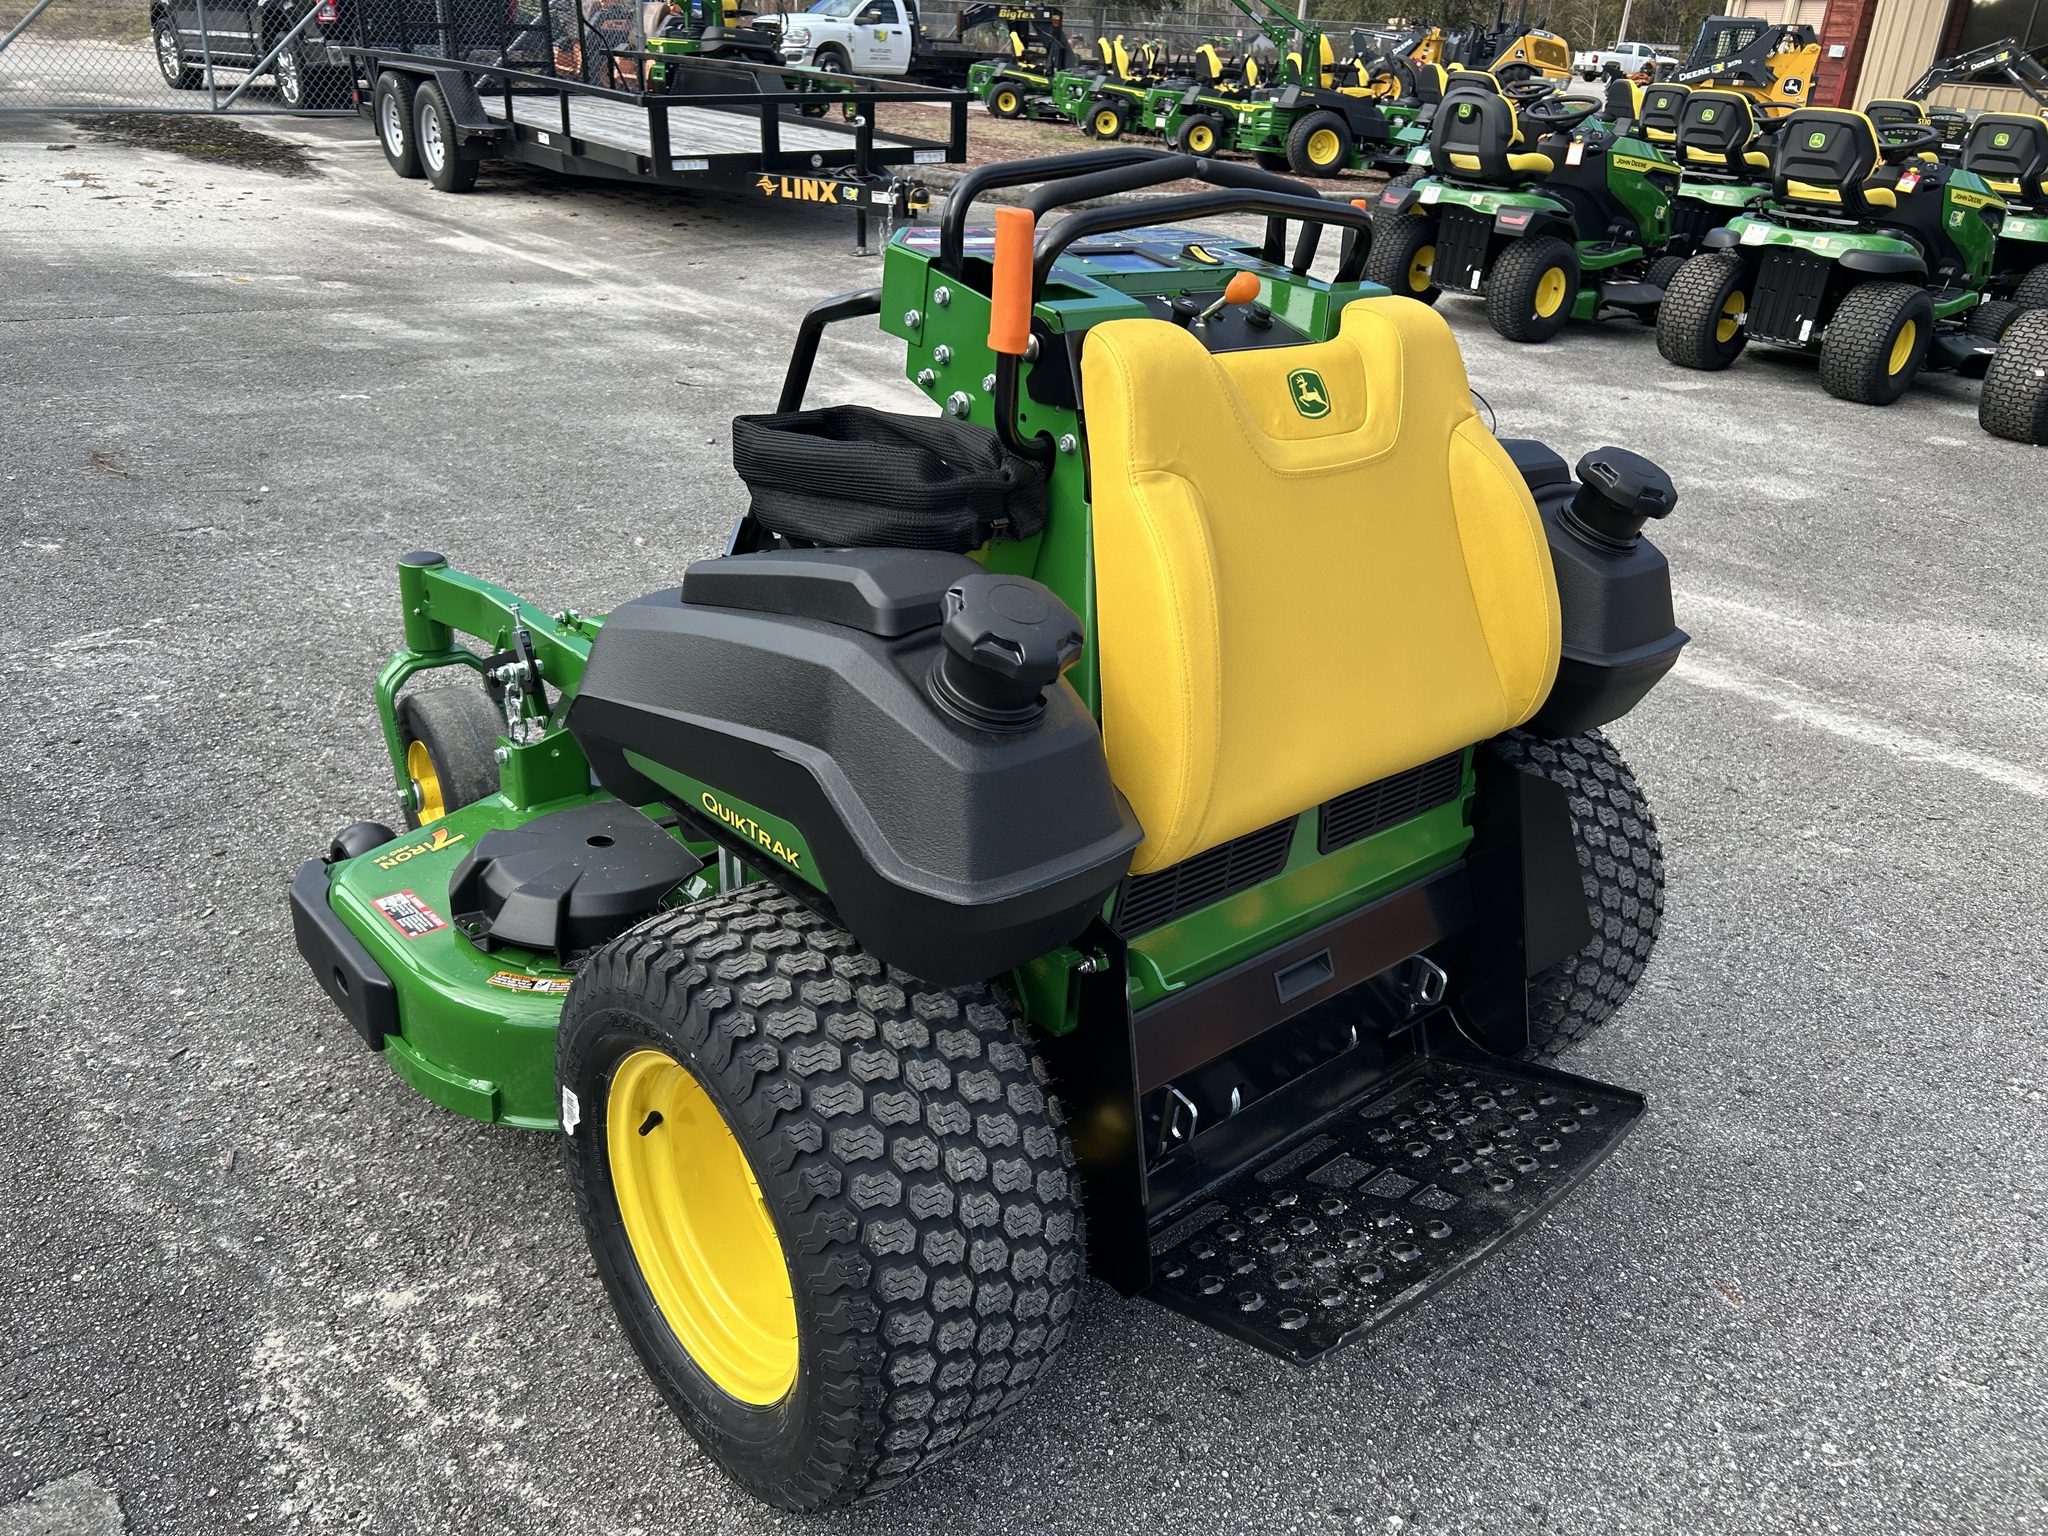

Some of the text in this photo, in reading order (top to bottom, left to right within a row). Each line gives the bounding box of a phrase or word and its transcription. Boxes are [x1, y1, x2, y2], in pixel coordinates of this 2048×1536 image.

[998, 9, 1036, 20] BigTex
[1392, 38, 1414, 56] DEERE
[1678, 66, 1711, 82] DEERE
[1917, 118, 1932, 126] S130
[1616, 158, 1648, 169] JOHN DEERE
[781, 176, 838, 204] LINX
[1953, 192, 1983, 205] JOHN DEERE
[701, 792, 801, 870] QUIKTRAK
